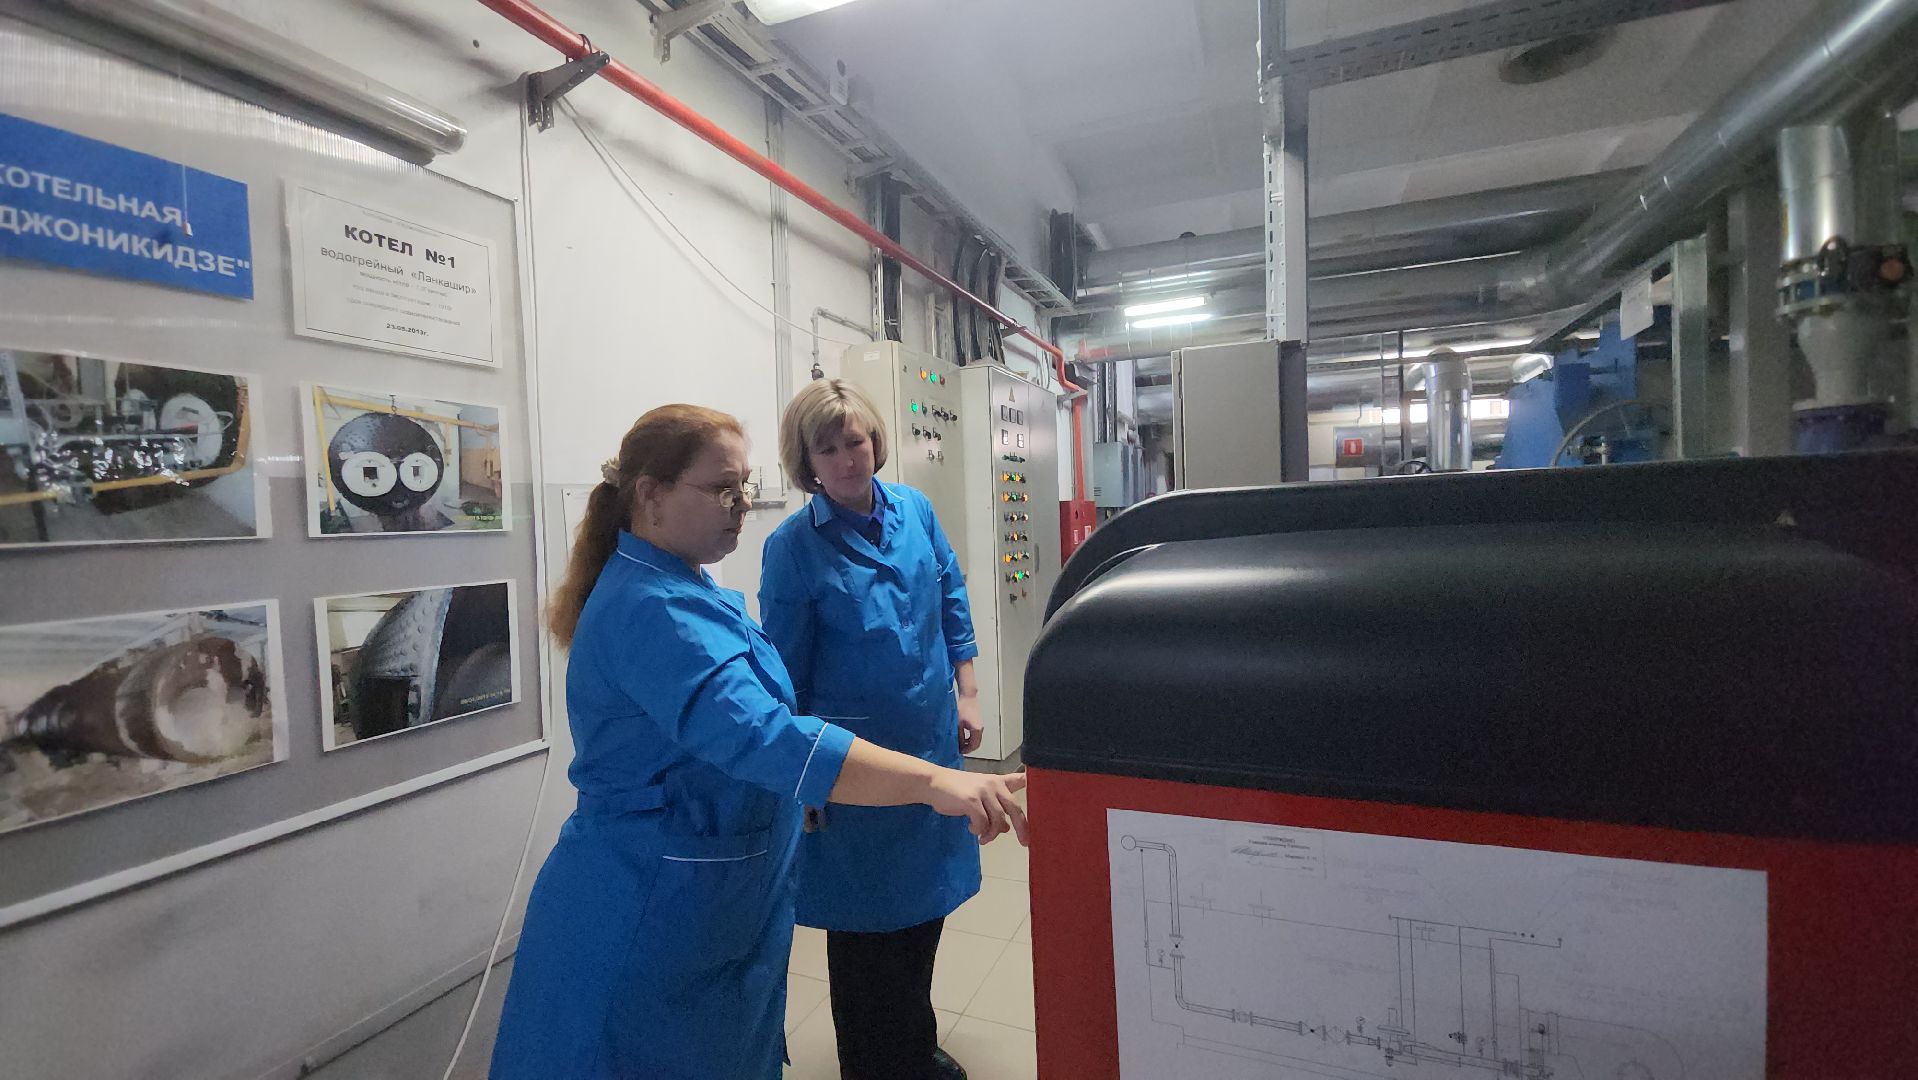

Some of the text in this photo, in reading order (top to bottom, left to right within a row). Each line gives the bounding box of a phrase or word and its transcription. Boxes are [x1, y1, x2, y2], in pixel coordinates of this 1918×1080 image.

[344, 224, 413, 257] КОТЕЛ
[425, 248, 456, 269] №1
[320, 247, 404, 277] водогрейный
[411, 270, 477, 295] «Ланкашир»
